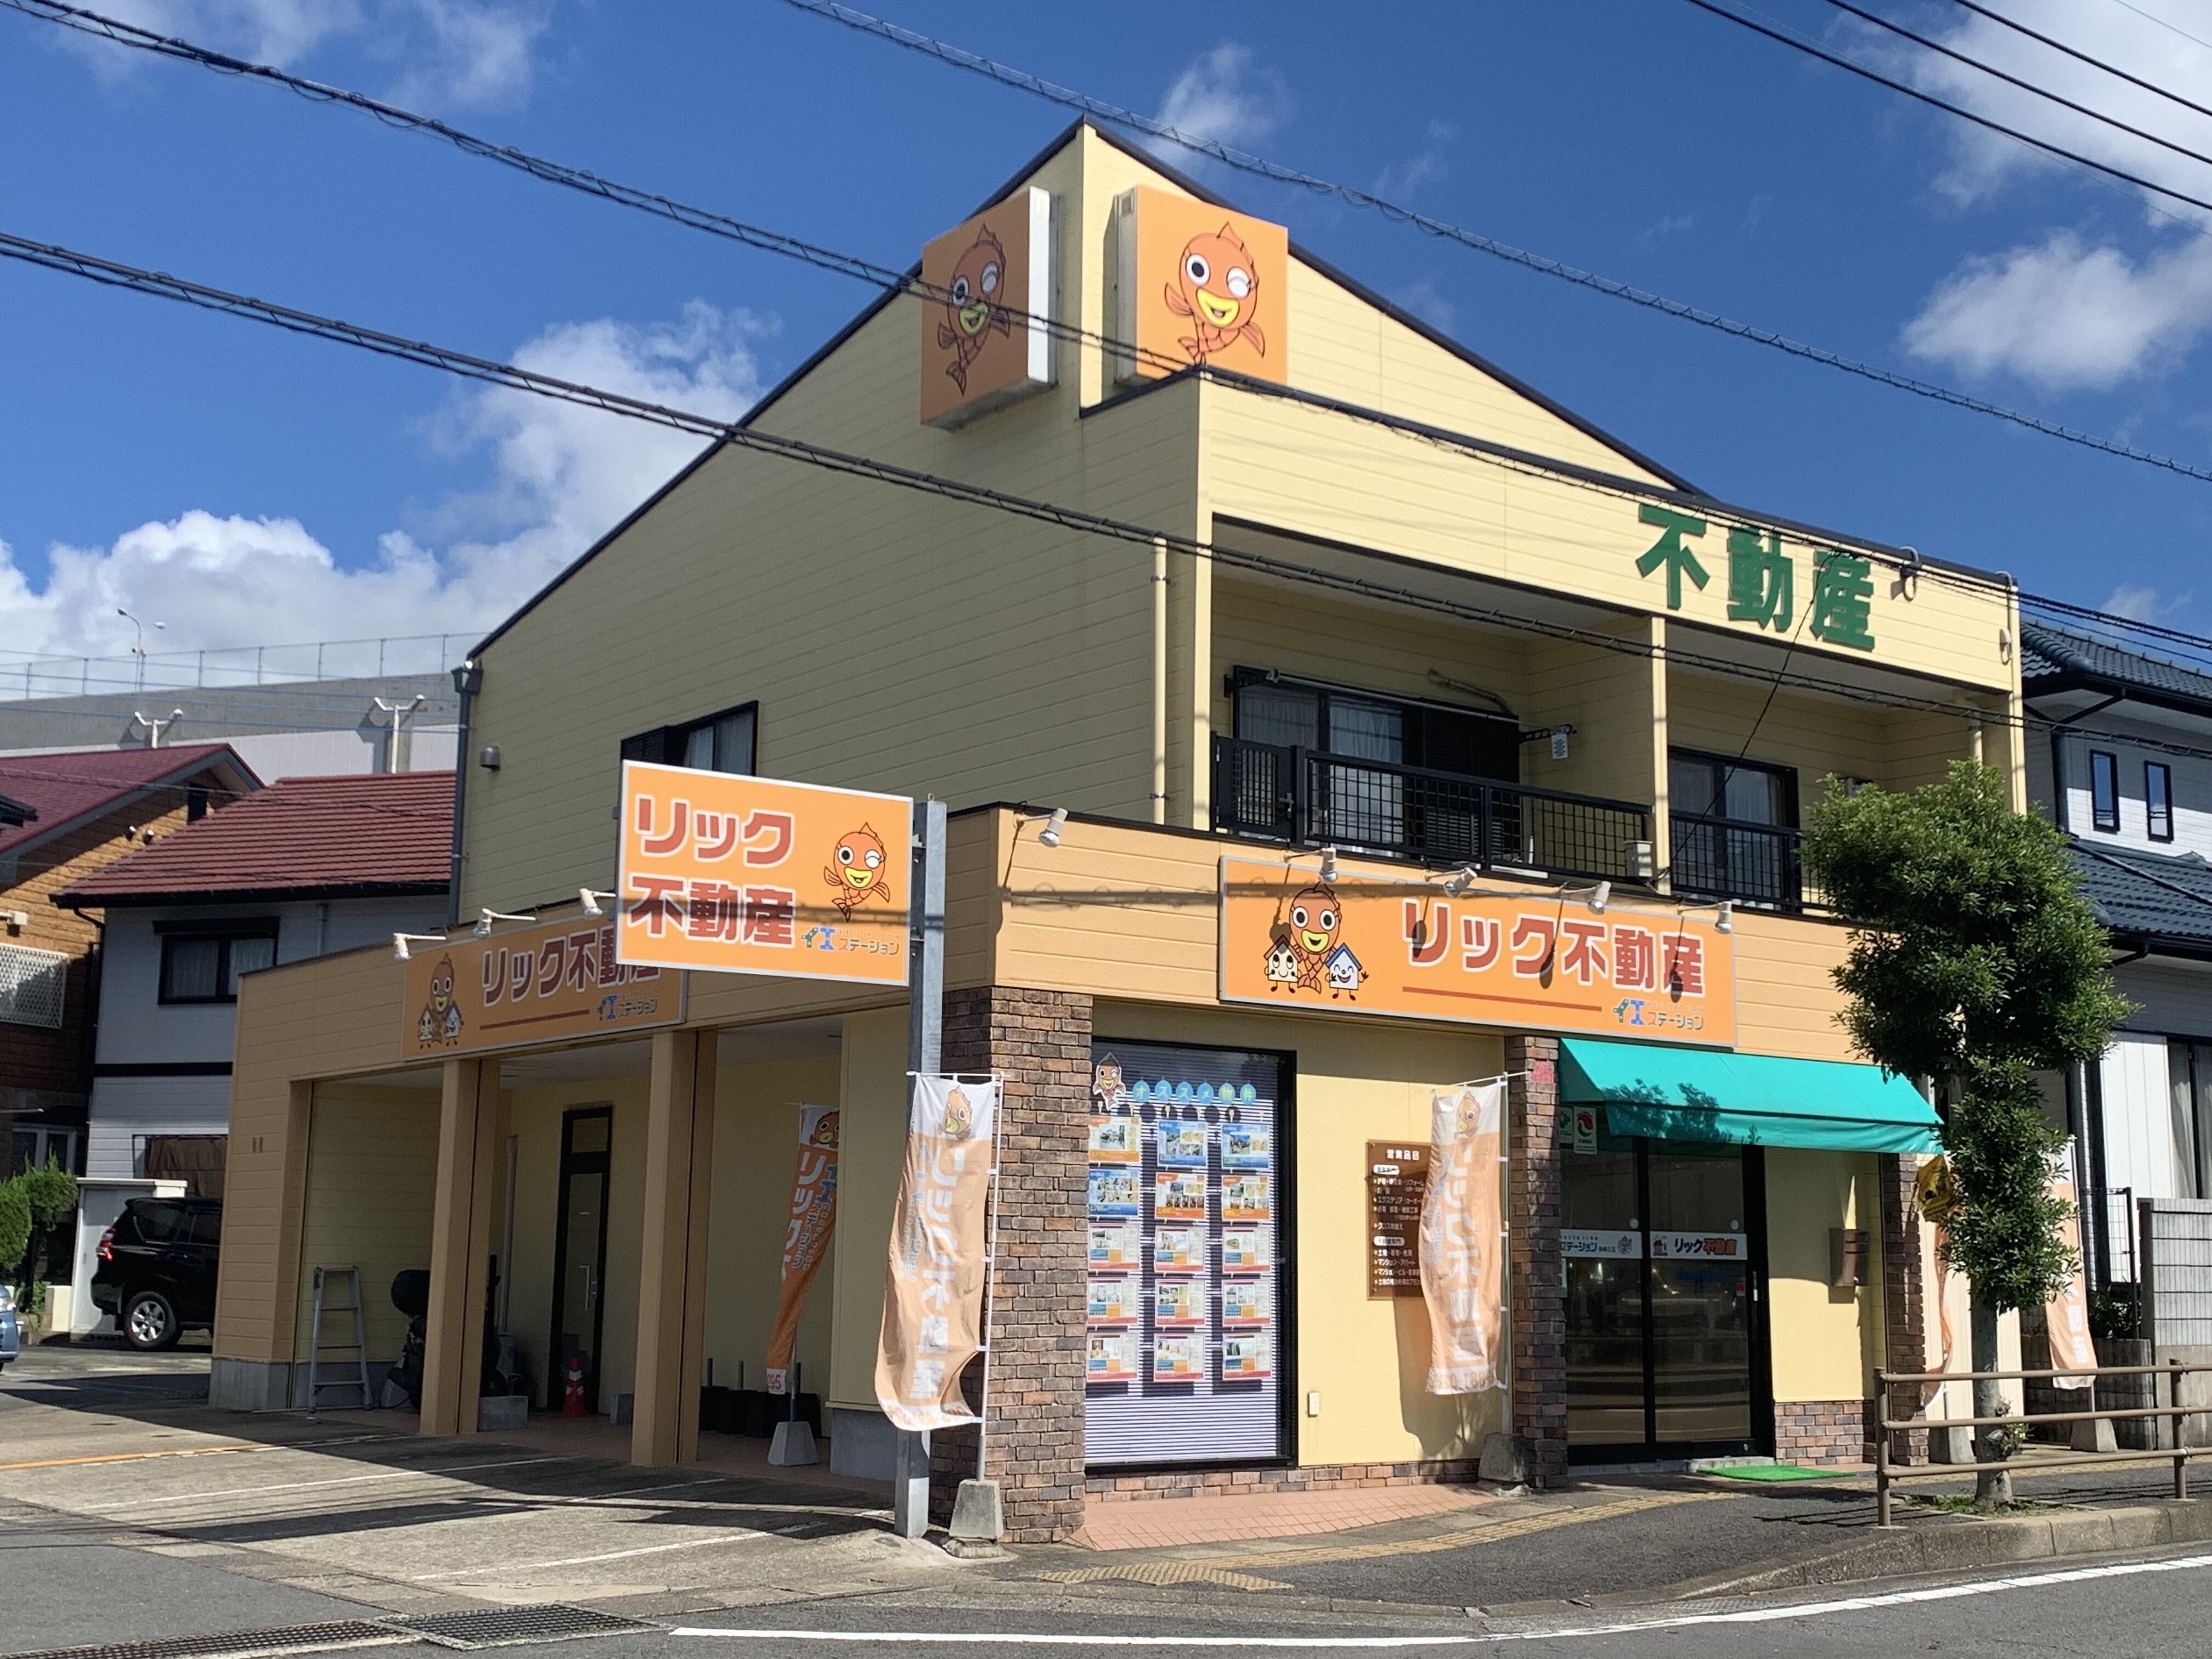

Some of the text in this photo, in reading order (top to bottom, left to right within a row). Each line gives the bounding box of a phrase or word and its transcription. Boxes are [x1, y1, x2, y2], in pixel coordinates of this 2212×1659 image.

[1635, 503, 1875, 652] 不動産
[635, 794, 795, 868] リック
[628, 872, 796, 948] 不動産
[801, 927, 900, 956] イエステーション
[1403, 898, 1706, 997] リック不動産
[1612, 998, 1703, 1031] イエステーション
[1135, 1085, 1254, 1102] オススメ物件
[1674, 1237, 1737, 1256] リック不動産
